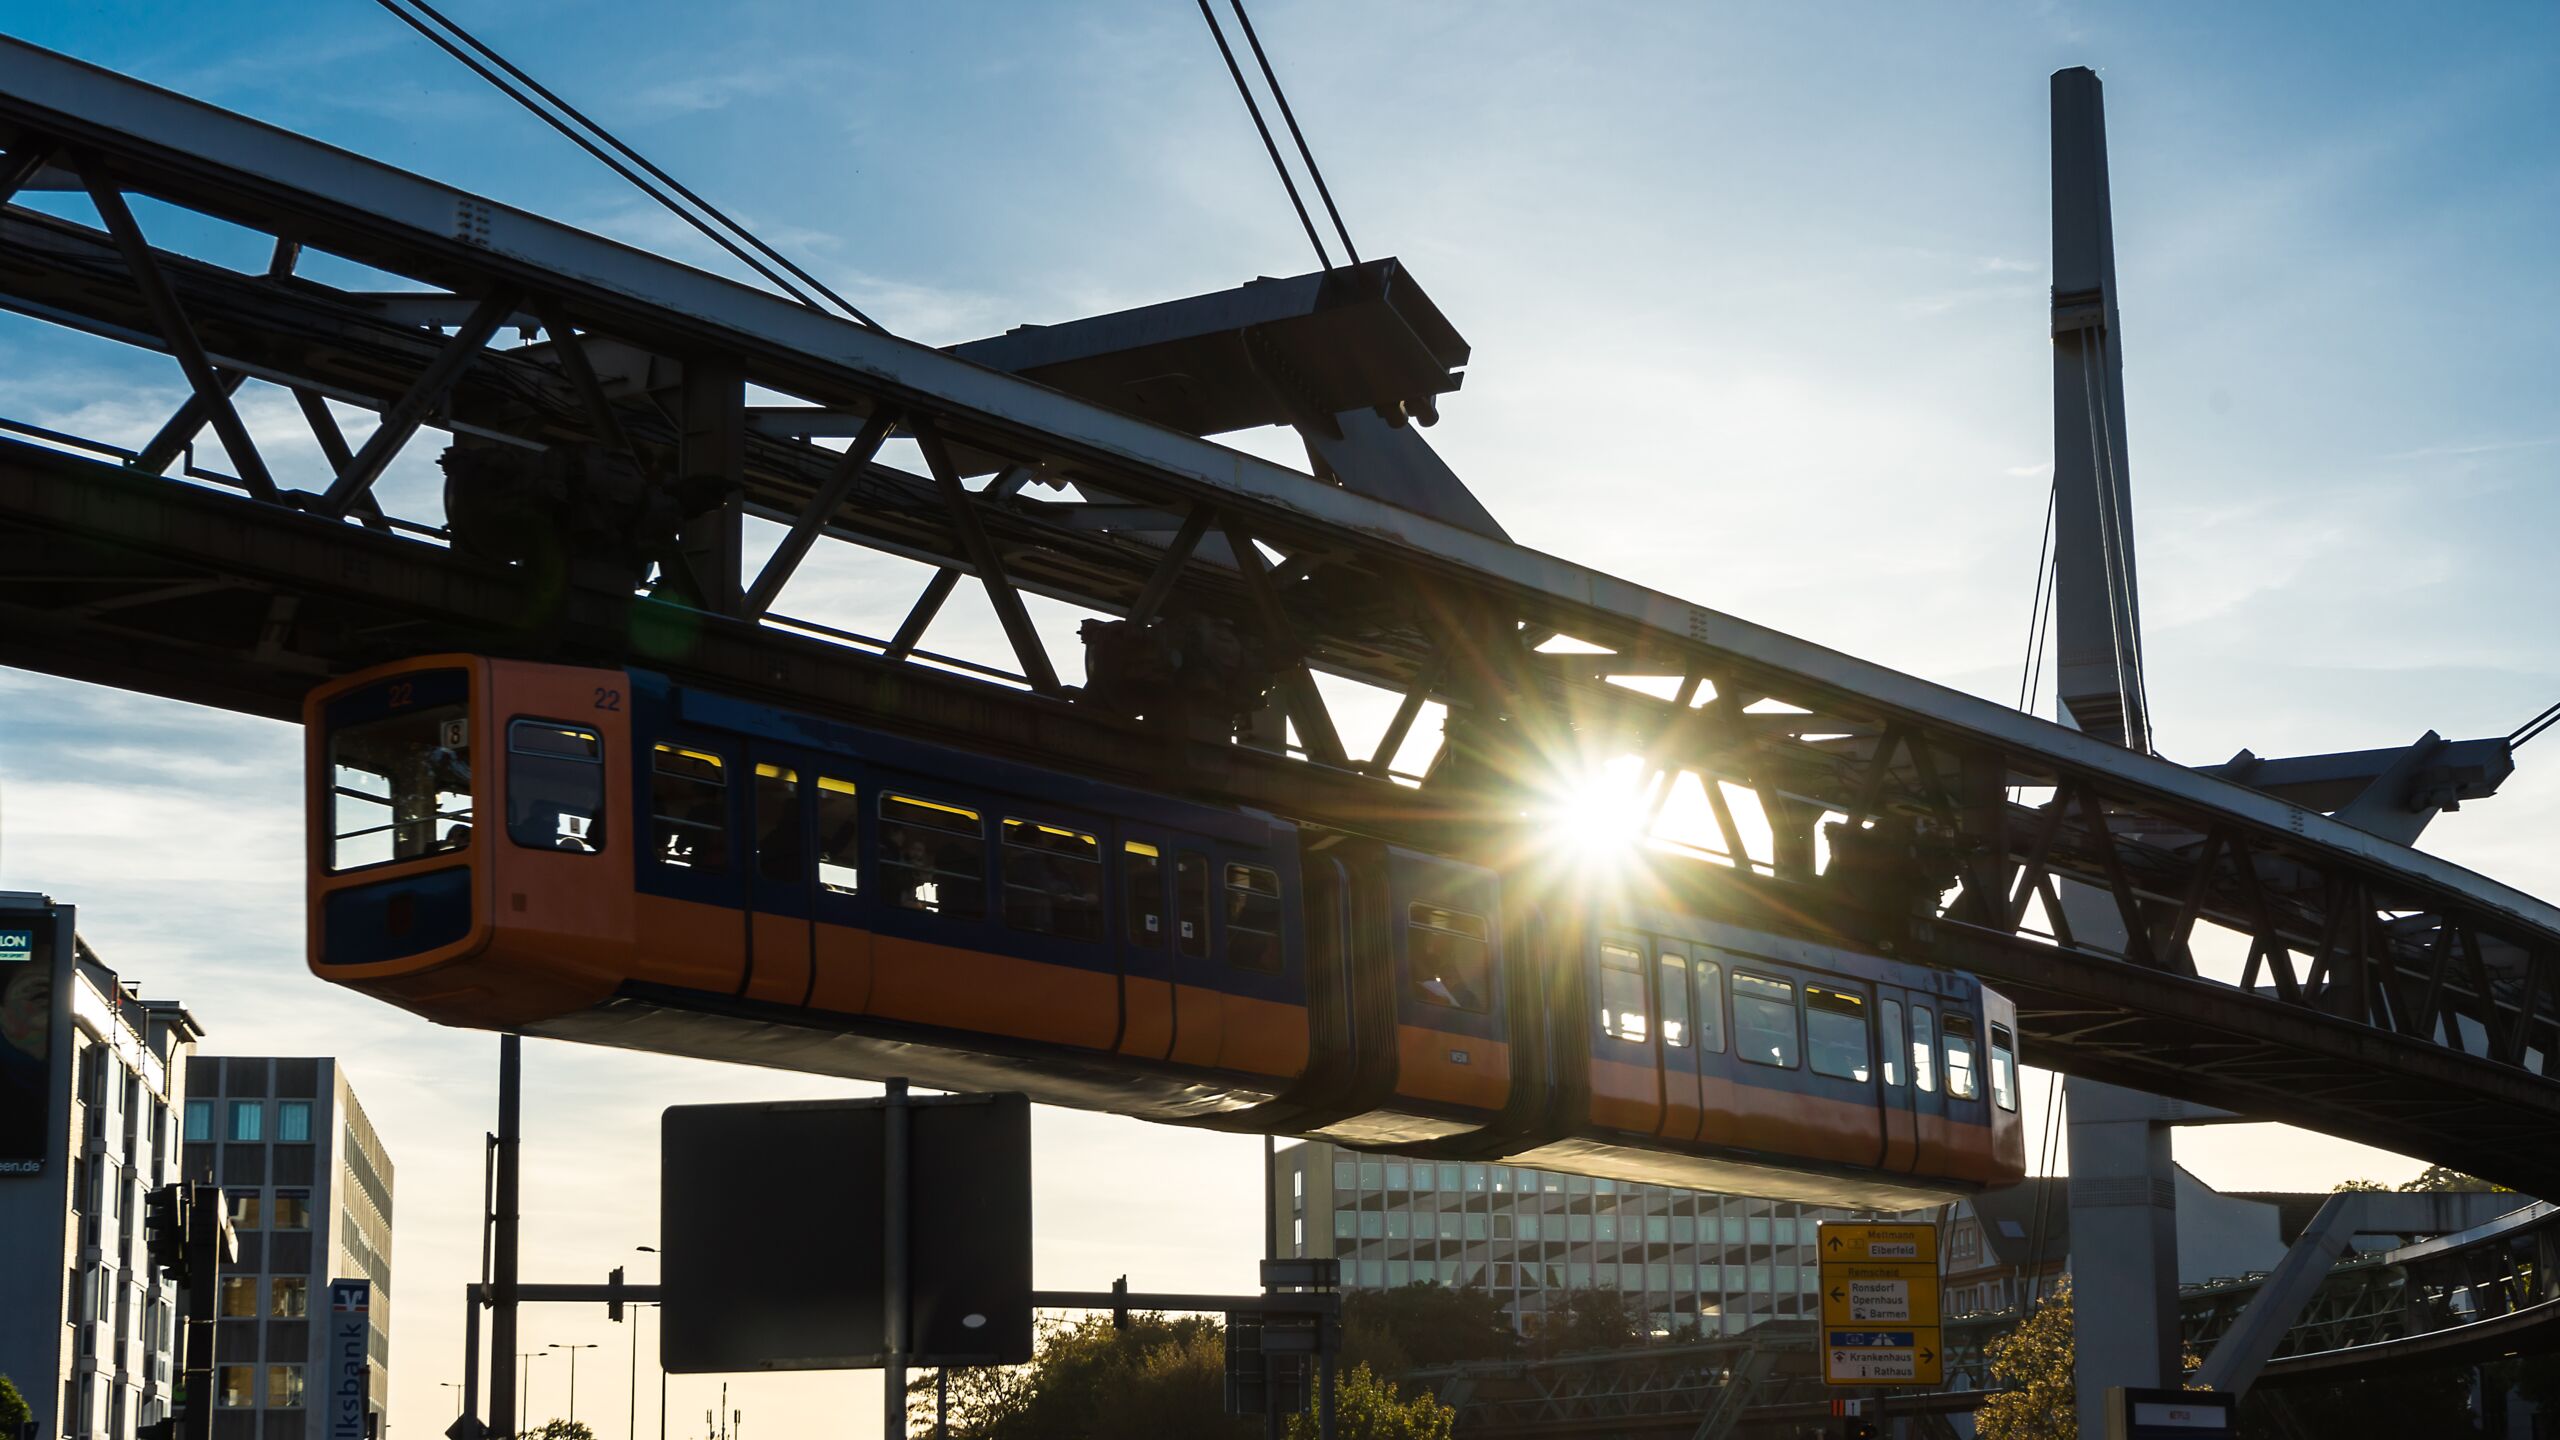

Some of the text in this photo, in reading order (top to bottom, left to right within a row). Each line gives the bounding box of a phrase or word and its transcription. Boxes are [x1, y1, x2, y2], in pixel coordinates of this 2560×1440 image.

[389, 683, 413, 708] 22
[594, 687, 620, 712] 22
[450, 724, 461, 745] 8
[1871, 1245, 1915, 1255] Elberfeld
[1848, 1267, 1900, 1278] Remscheid
[1852, 1283, 1895, 1293] Ronsdorf
[1853, 1296, 1903, 1307] Opernhaus
[1870, 1309, 1907, 1319] Barmen
[1850, 1353, 1912, 1362] Krankenhaus
[1874, 1367, 1912, 1377] Rathaus
